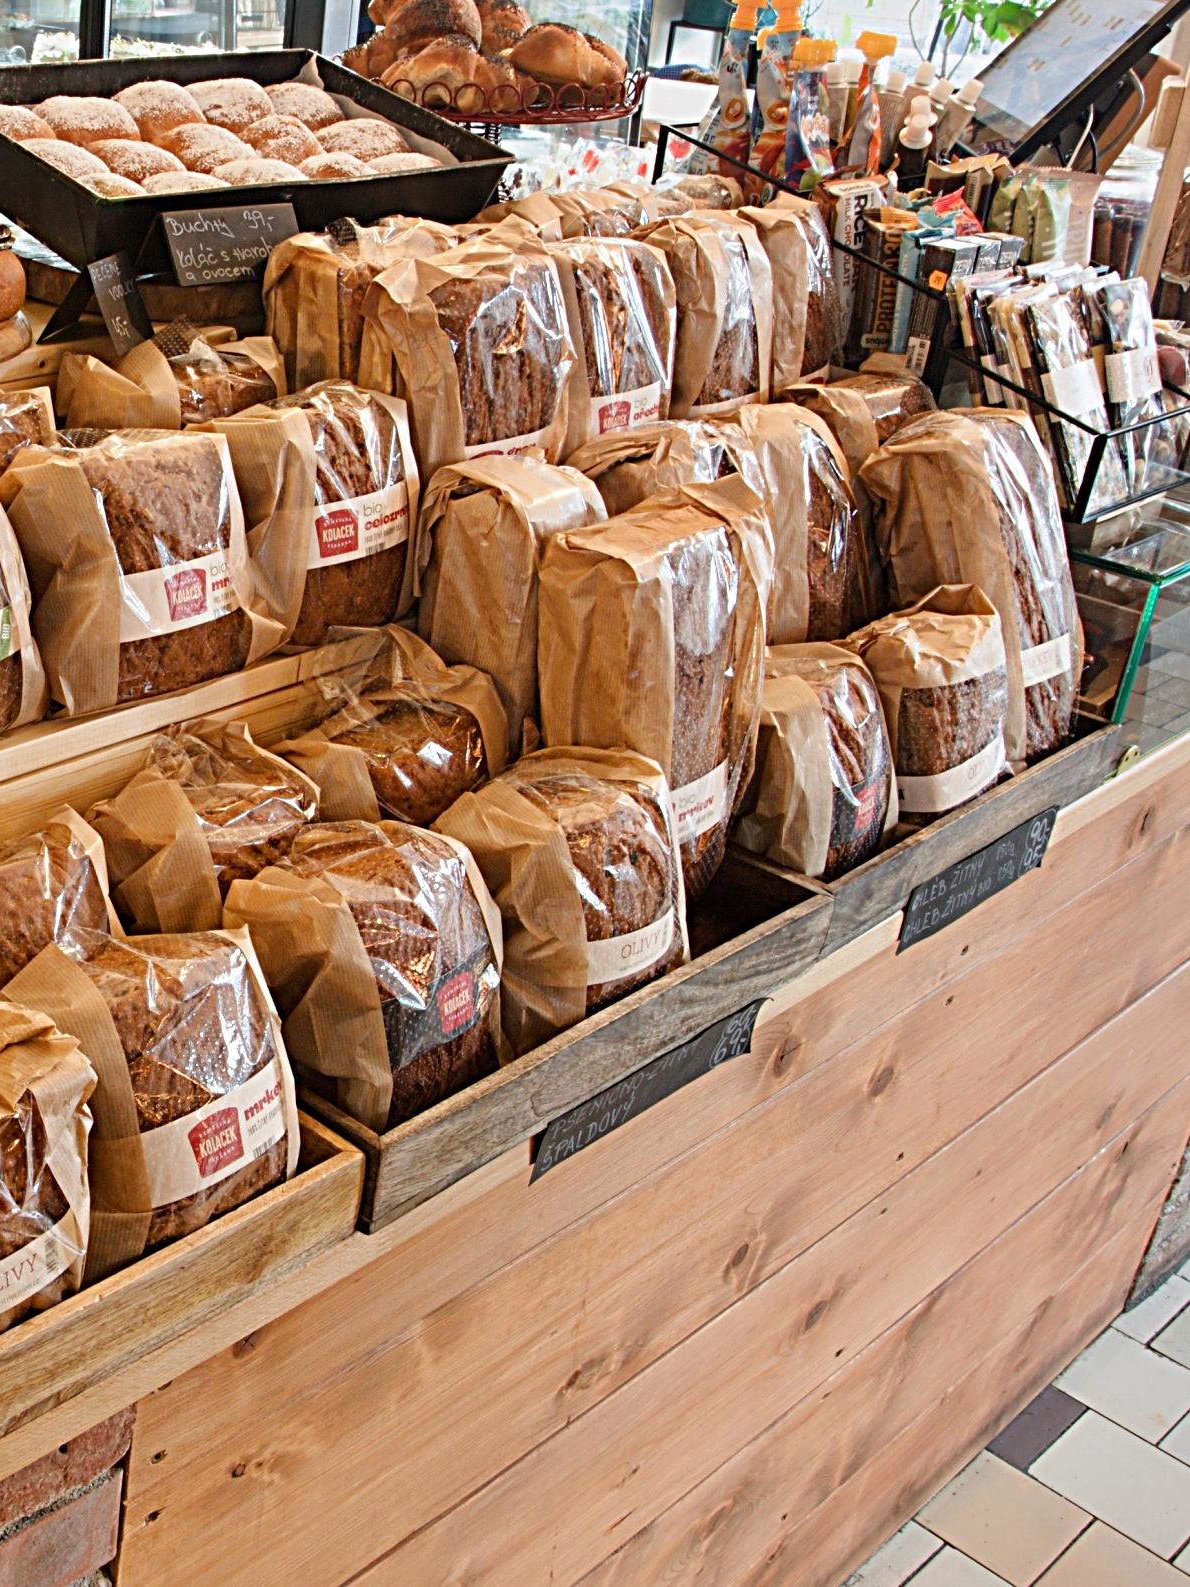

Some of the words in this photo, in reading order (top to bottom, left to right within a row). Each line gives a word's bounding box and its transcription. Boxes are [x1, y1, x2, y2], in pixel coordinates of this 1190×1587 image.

[166, 212, 236, 239] Buchty
[176, 243, 218, 268] Koláč
[842, 224, 852, 288] CHOOLATE
[202, 266, 256, 280] ovocem
[363, 503, 383, 517] bio
